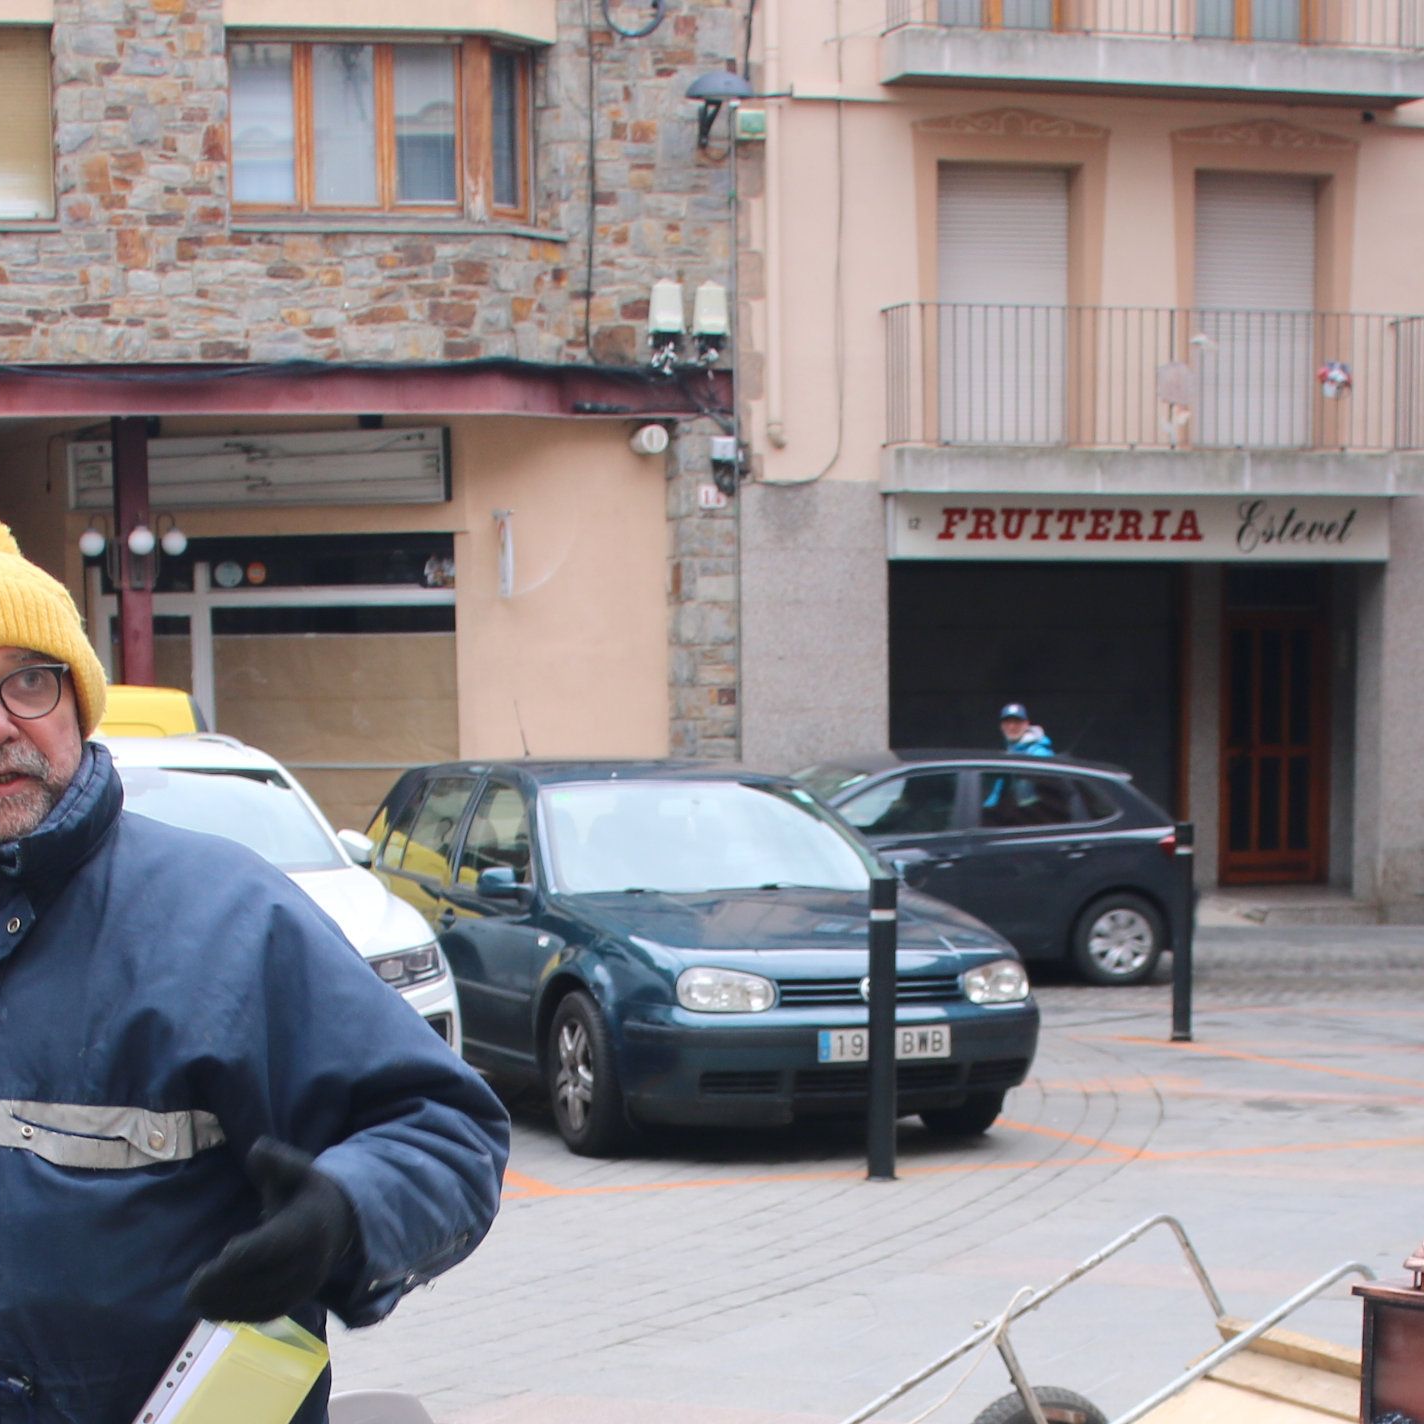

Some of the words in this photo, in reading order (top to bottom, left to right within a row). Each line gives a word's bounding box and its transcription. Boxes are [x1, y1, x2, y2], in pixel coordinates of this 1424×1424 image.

[937, 507, 1204, 541] FRUITERIA
[1237, 499, 1357, 554] Estevet
[837, 1033, 864, 1057] 19
